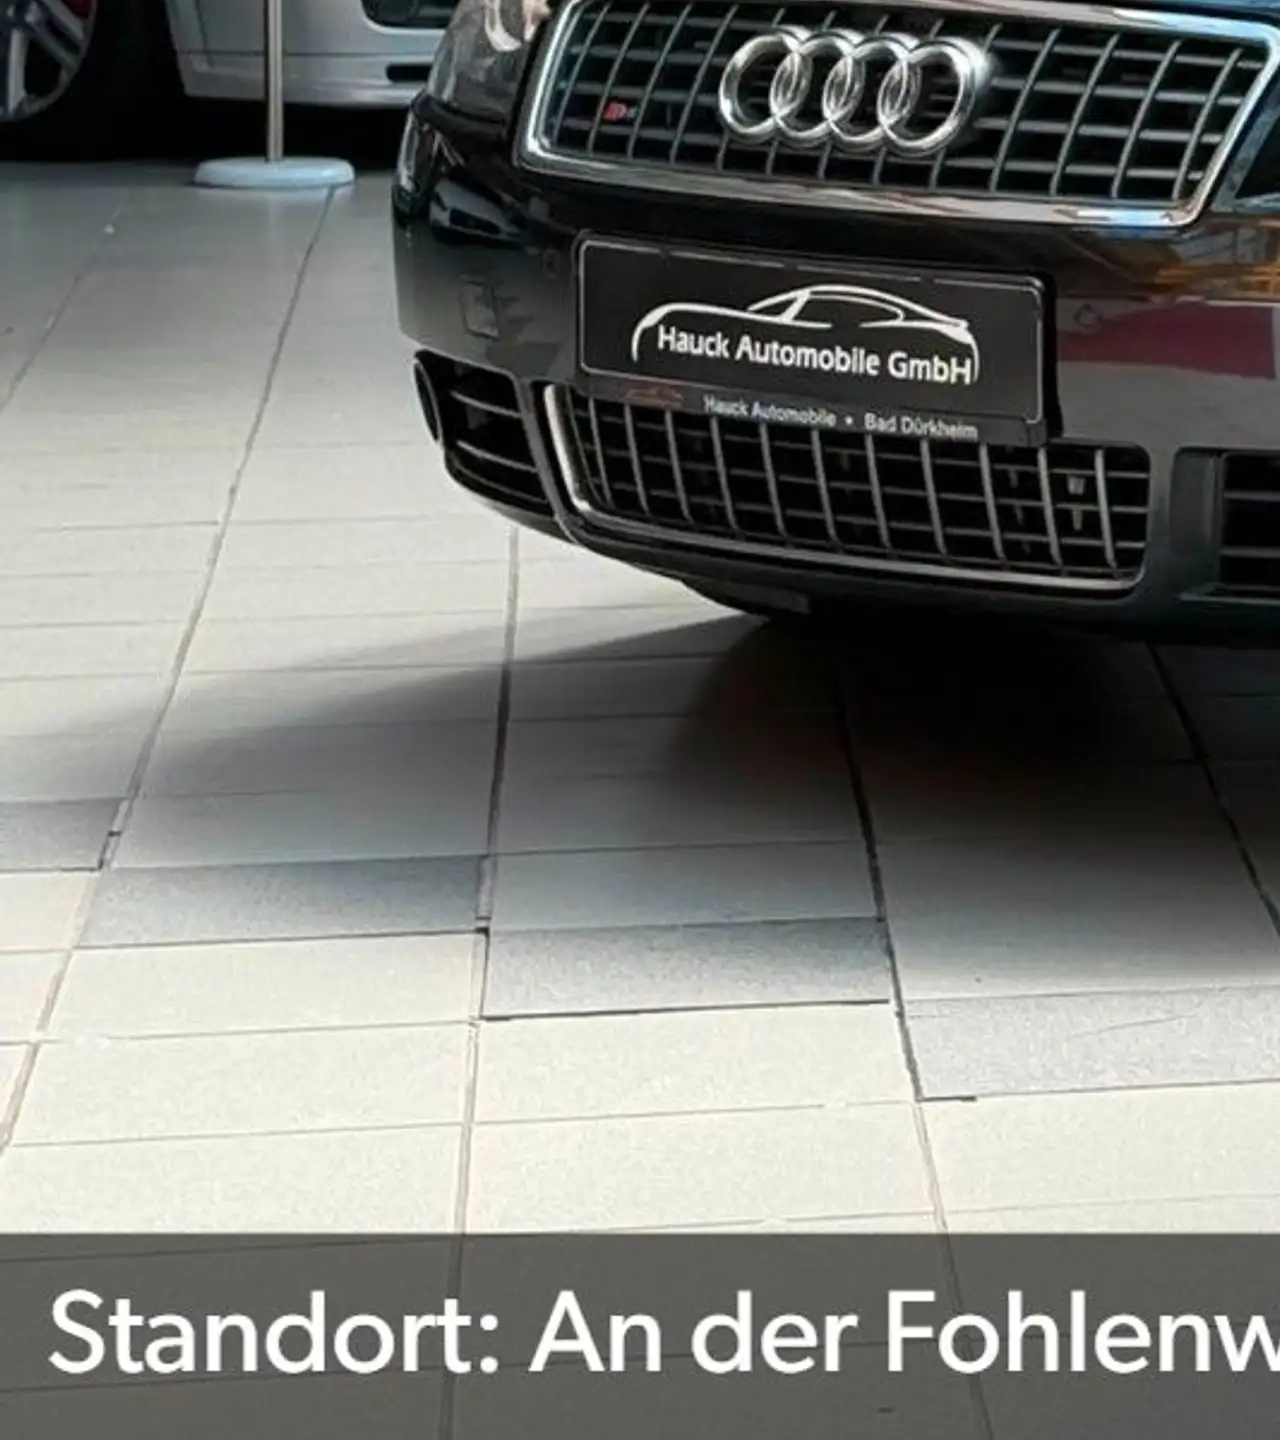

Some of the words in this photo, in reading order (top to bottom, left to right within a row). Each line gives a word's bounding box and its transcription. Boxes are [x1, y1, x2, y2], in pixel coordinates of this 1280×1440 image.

[657, 323, 731, 359] Hauck
[735, 334, 881, 377] Automobile
[887, 350, 972, 386] GmbH
[703, 394, 749, 417] Hauck
[751, 400, 837, 428] Automobile
[864, 412, 897, 433] Bad
